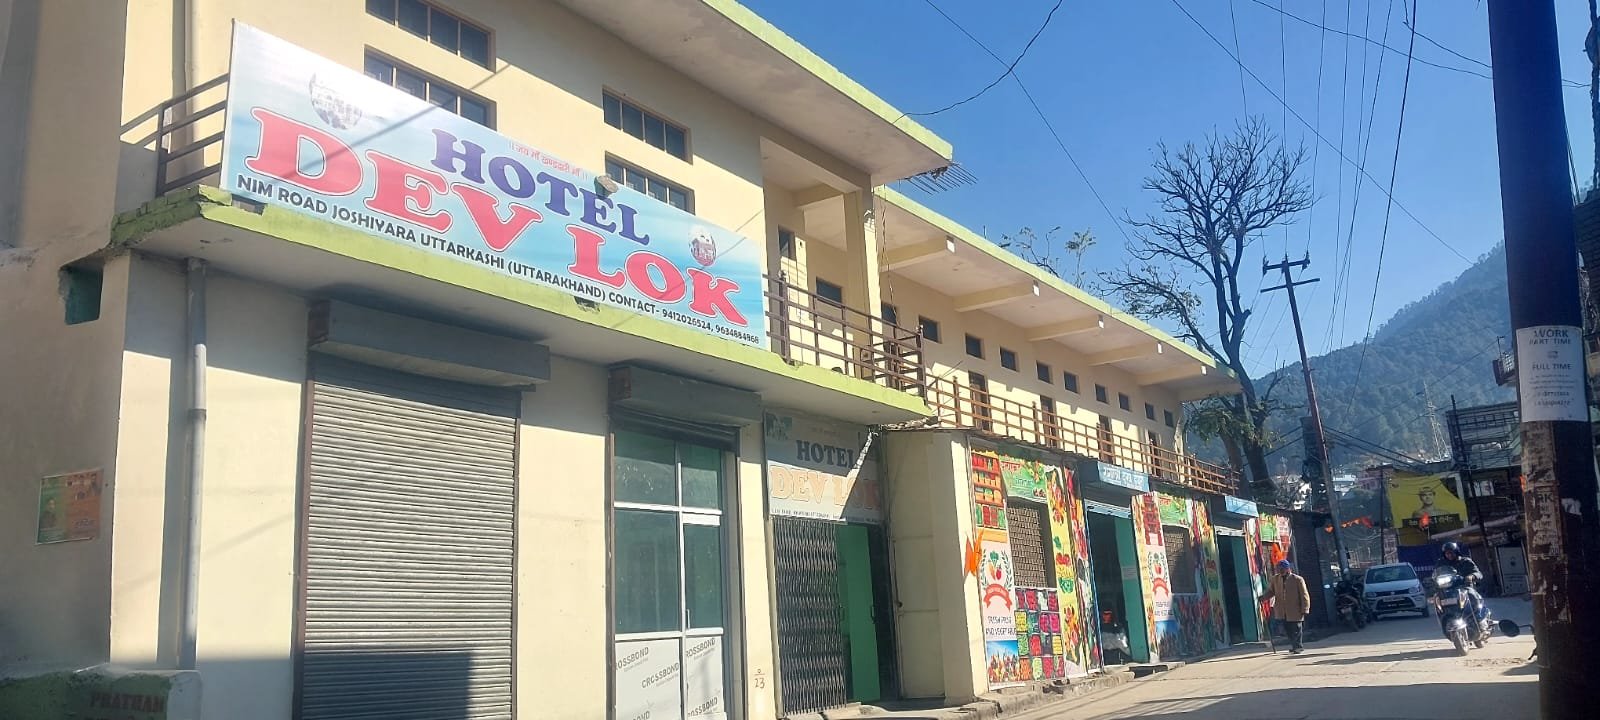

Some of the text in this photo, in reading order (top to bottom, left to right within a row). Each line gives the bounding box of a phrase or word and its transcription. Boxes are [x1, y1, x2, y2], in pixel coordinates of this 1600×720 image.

[432, 128, 649, 246] HOTEL
[246, 107, 748, 326] DEV LOK
[237, 174, 273, 198] NIM
[278, 190, 328, 214] ROAD
[332, 204, 417, 243] JOSHIYARA
[420, 233, 505, 270] UTTARKASHI
[508, 260, 606, 301] (UTTARAKHAND)
[609, 292, 660, 315] CONTACT-
[1533, 328, 1569, 338] WORK
[1554, 337, 1572, 345] TIME
[1532, 363, 1572, 371] FULL TIME
[796, 440, 856, 468] HOTEL
[769, 464, 828, 504] DEV
[641, 662, 679, 689] CROSSBOND
[754, 677, 765, 689] 23
